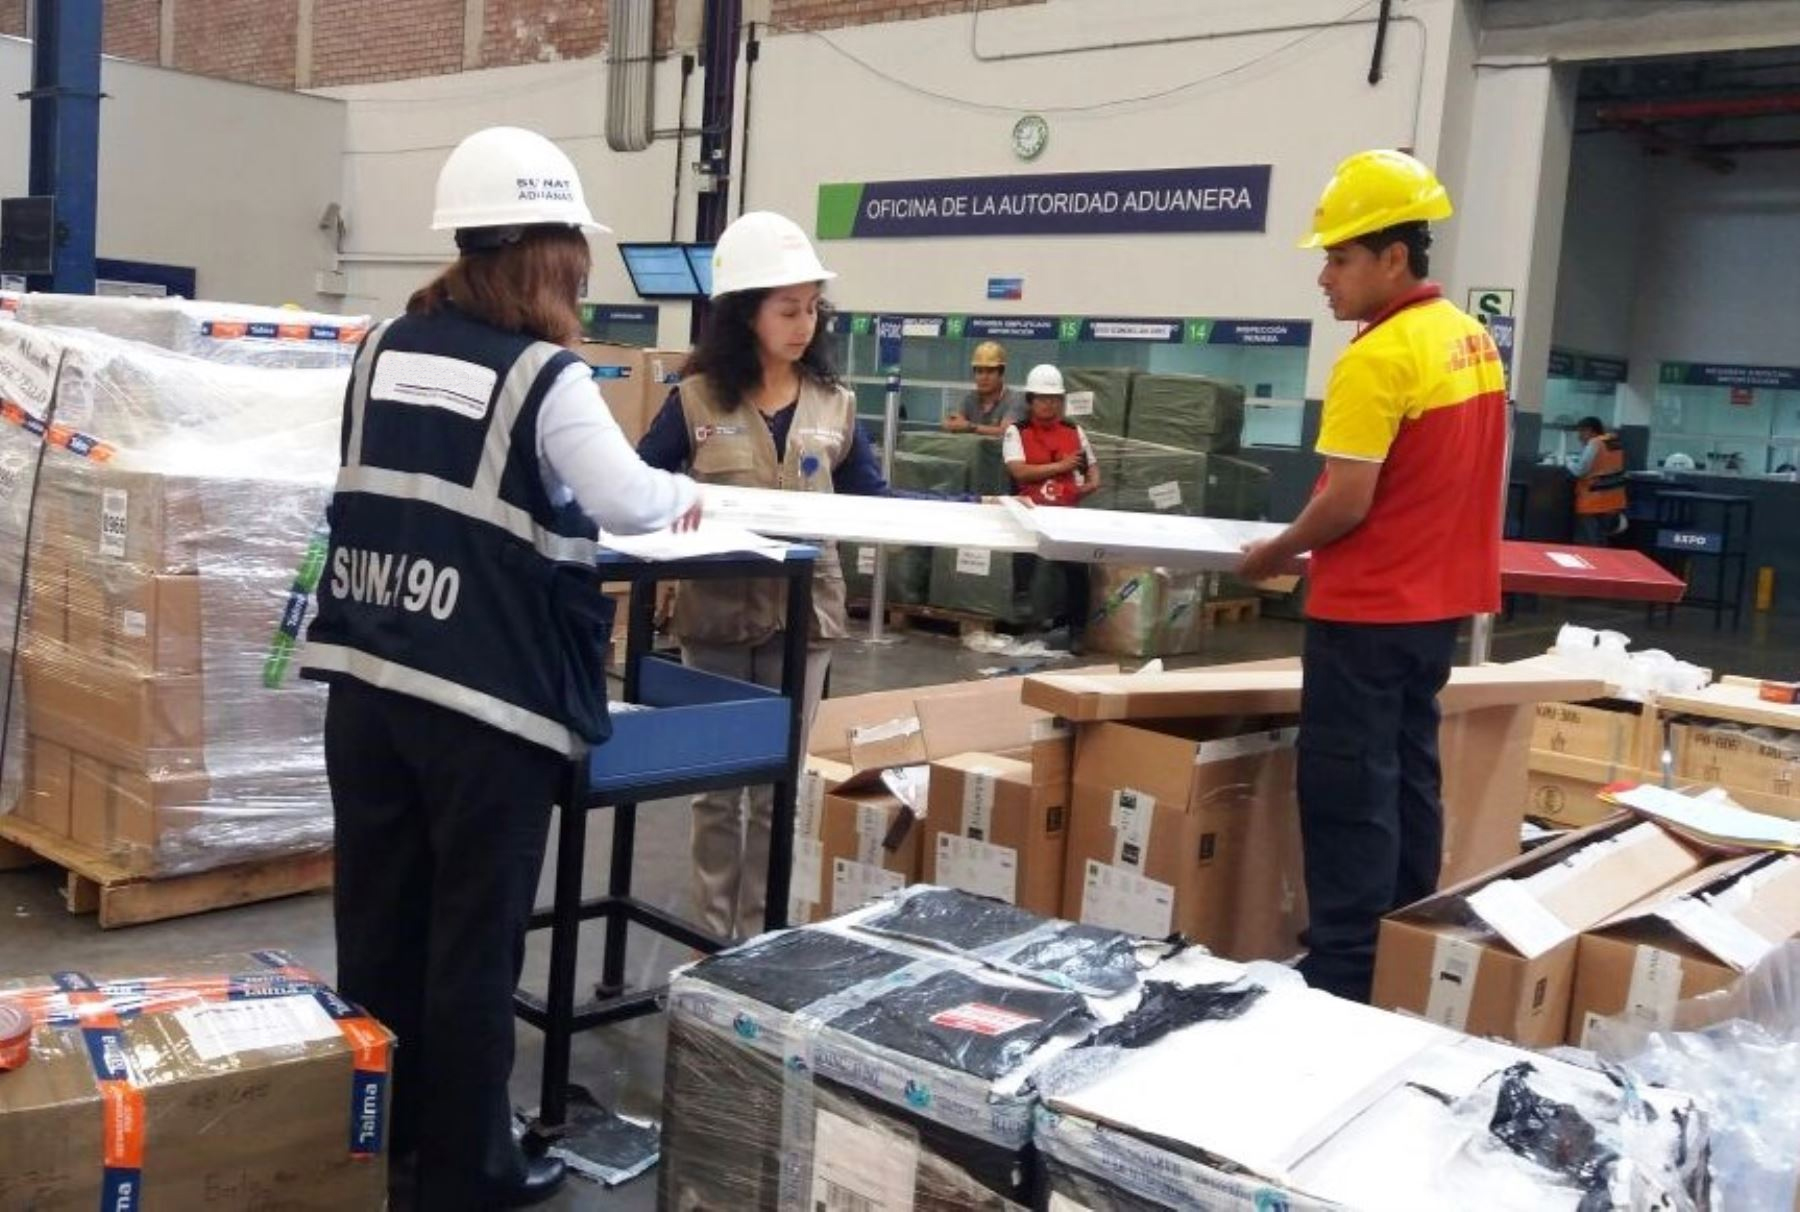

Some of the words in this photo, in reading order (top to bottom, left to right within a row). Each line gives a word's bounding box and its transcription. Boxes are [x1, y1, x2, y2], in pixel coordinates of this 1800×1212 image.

[867, 198, 937, 219] OFICINA
[941, 196, 968, 216] DE
[972, 194, 995, 215] LA
[998, 191, 1118, 215] AUTORIDAD
[1123, 187, 1252, 212] ADUANERA
[1060, 321, 1077, 337] 15
[1190, 323, 1206, 340] 14
[359, 1083, 378, 1144] Talma
